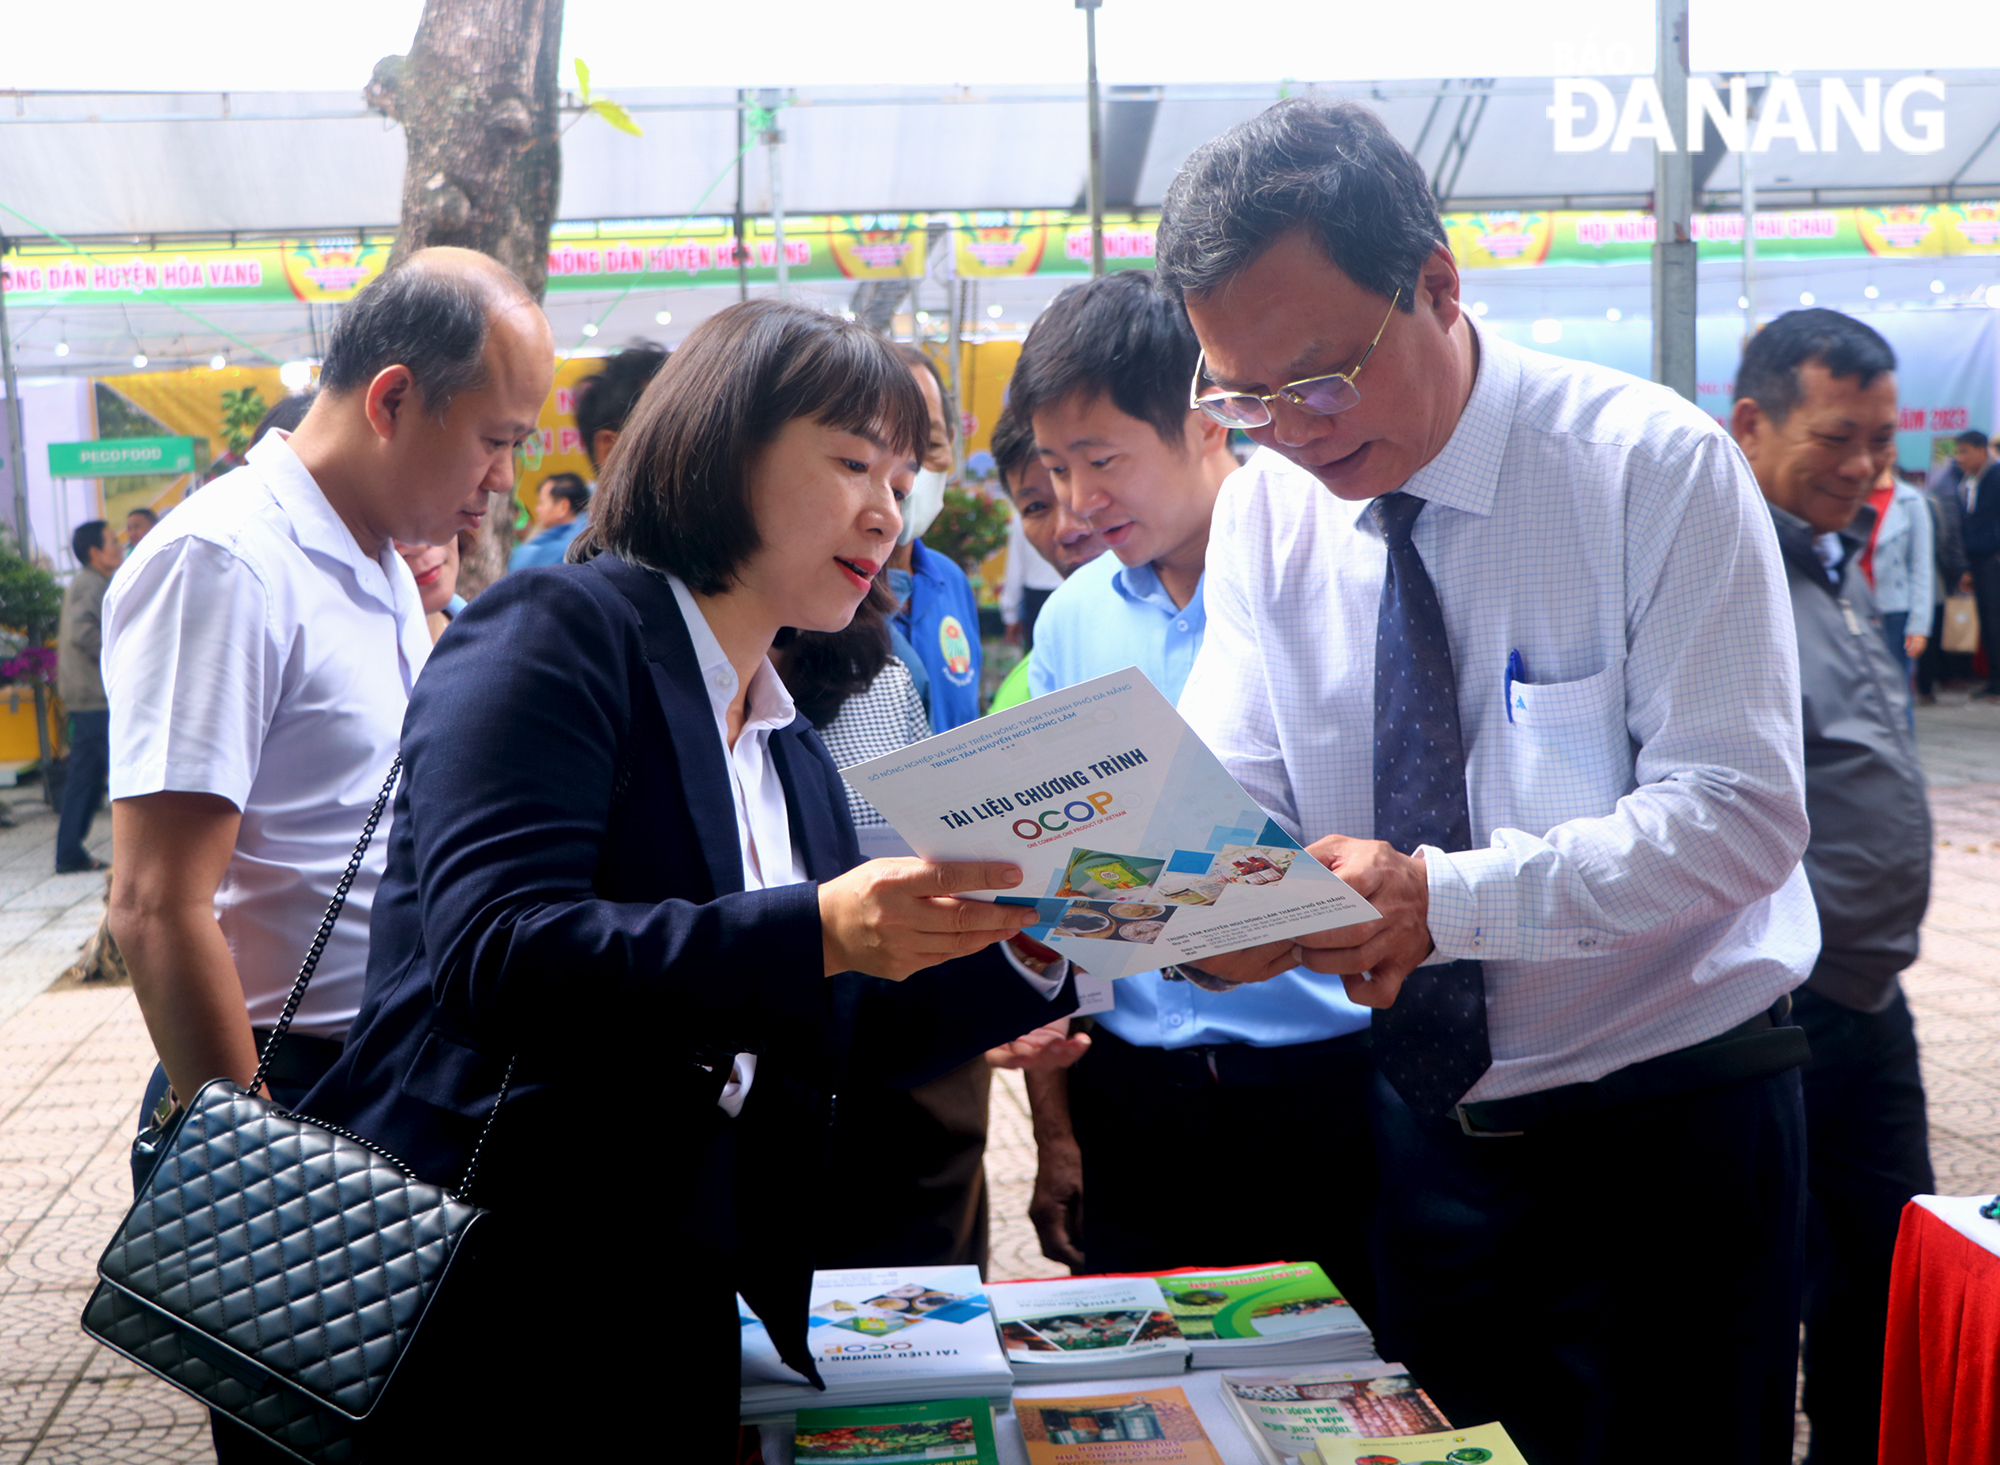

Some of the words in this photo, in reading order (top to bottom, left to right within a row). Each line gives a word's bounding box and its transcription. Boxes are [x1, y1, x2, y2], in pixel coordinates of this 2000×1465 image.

[1704, 213, 1744, 243] QUẬ
[548, 243, 600, 274] NÔNG
[605, 242, 643, 272] DÂN
[648, 239, 710, 275] HUYỆN
[1065, 229, 1093, 264] HỘ
[1, 262, 42, 291] ÔNG
[47, 260, 87, 290] DÂN
[93, 258, 158, 294] HUYỆN
[163, 258, 205, 288] HÒA
[208, 261, 262, 287] VANG
[1897, 405, 1925, 431] ĂM
[1929, 406, 1967, 430] 2023
[80, 446, 162, 463] PECOFOOD
[879, 765, 904, 777] NÔNG
[946, 742, 967, 753] PHÁT
[992, 723, 1018, 736] NÔNG
[1018, 714, 1042, 726] THÔN
[1042, 704, 1072, 717] THÀNH
[930, 755, 958, 768] TRUNG
[958, 749, 977, 758] TÂM
[977, 735, 1011, 752] KHUYẾN
[1031, 718, 1057, 731] NÔNG
[1057, 711, 1076, 722] LÂM
[940, 810, 973, 828] TÀI
[971, 797, 1013, 819] LIỆU
[1014, 771, 1089, 805] CHƯƠNG
[1088, 748, 1147, 778] TRÌNH
[1012, 792, 1111, 839] OCOP
[1037, 834, 1062, 845] COMMUNE
[1072, 821, 1096, 832] PRODUCT
[1104, 810, 1126, 821] VIETNAM
[823, 1342, 912, 1353] OCOP
[830, 1353, 891, 1362] CHƯƠNG
[897, 1349, 929, 1358] LIỆU
[935, 1348, 958, 1356] TÀI
